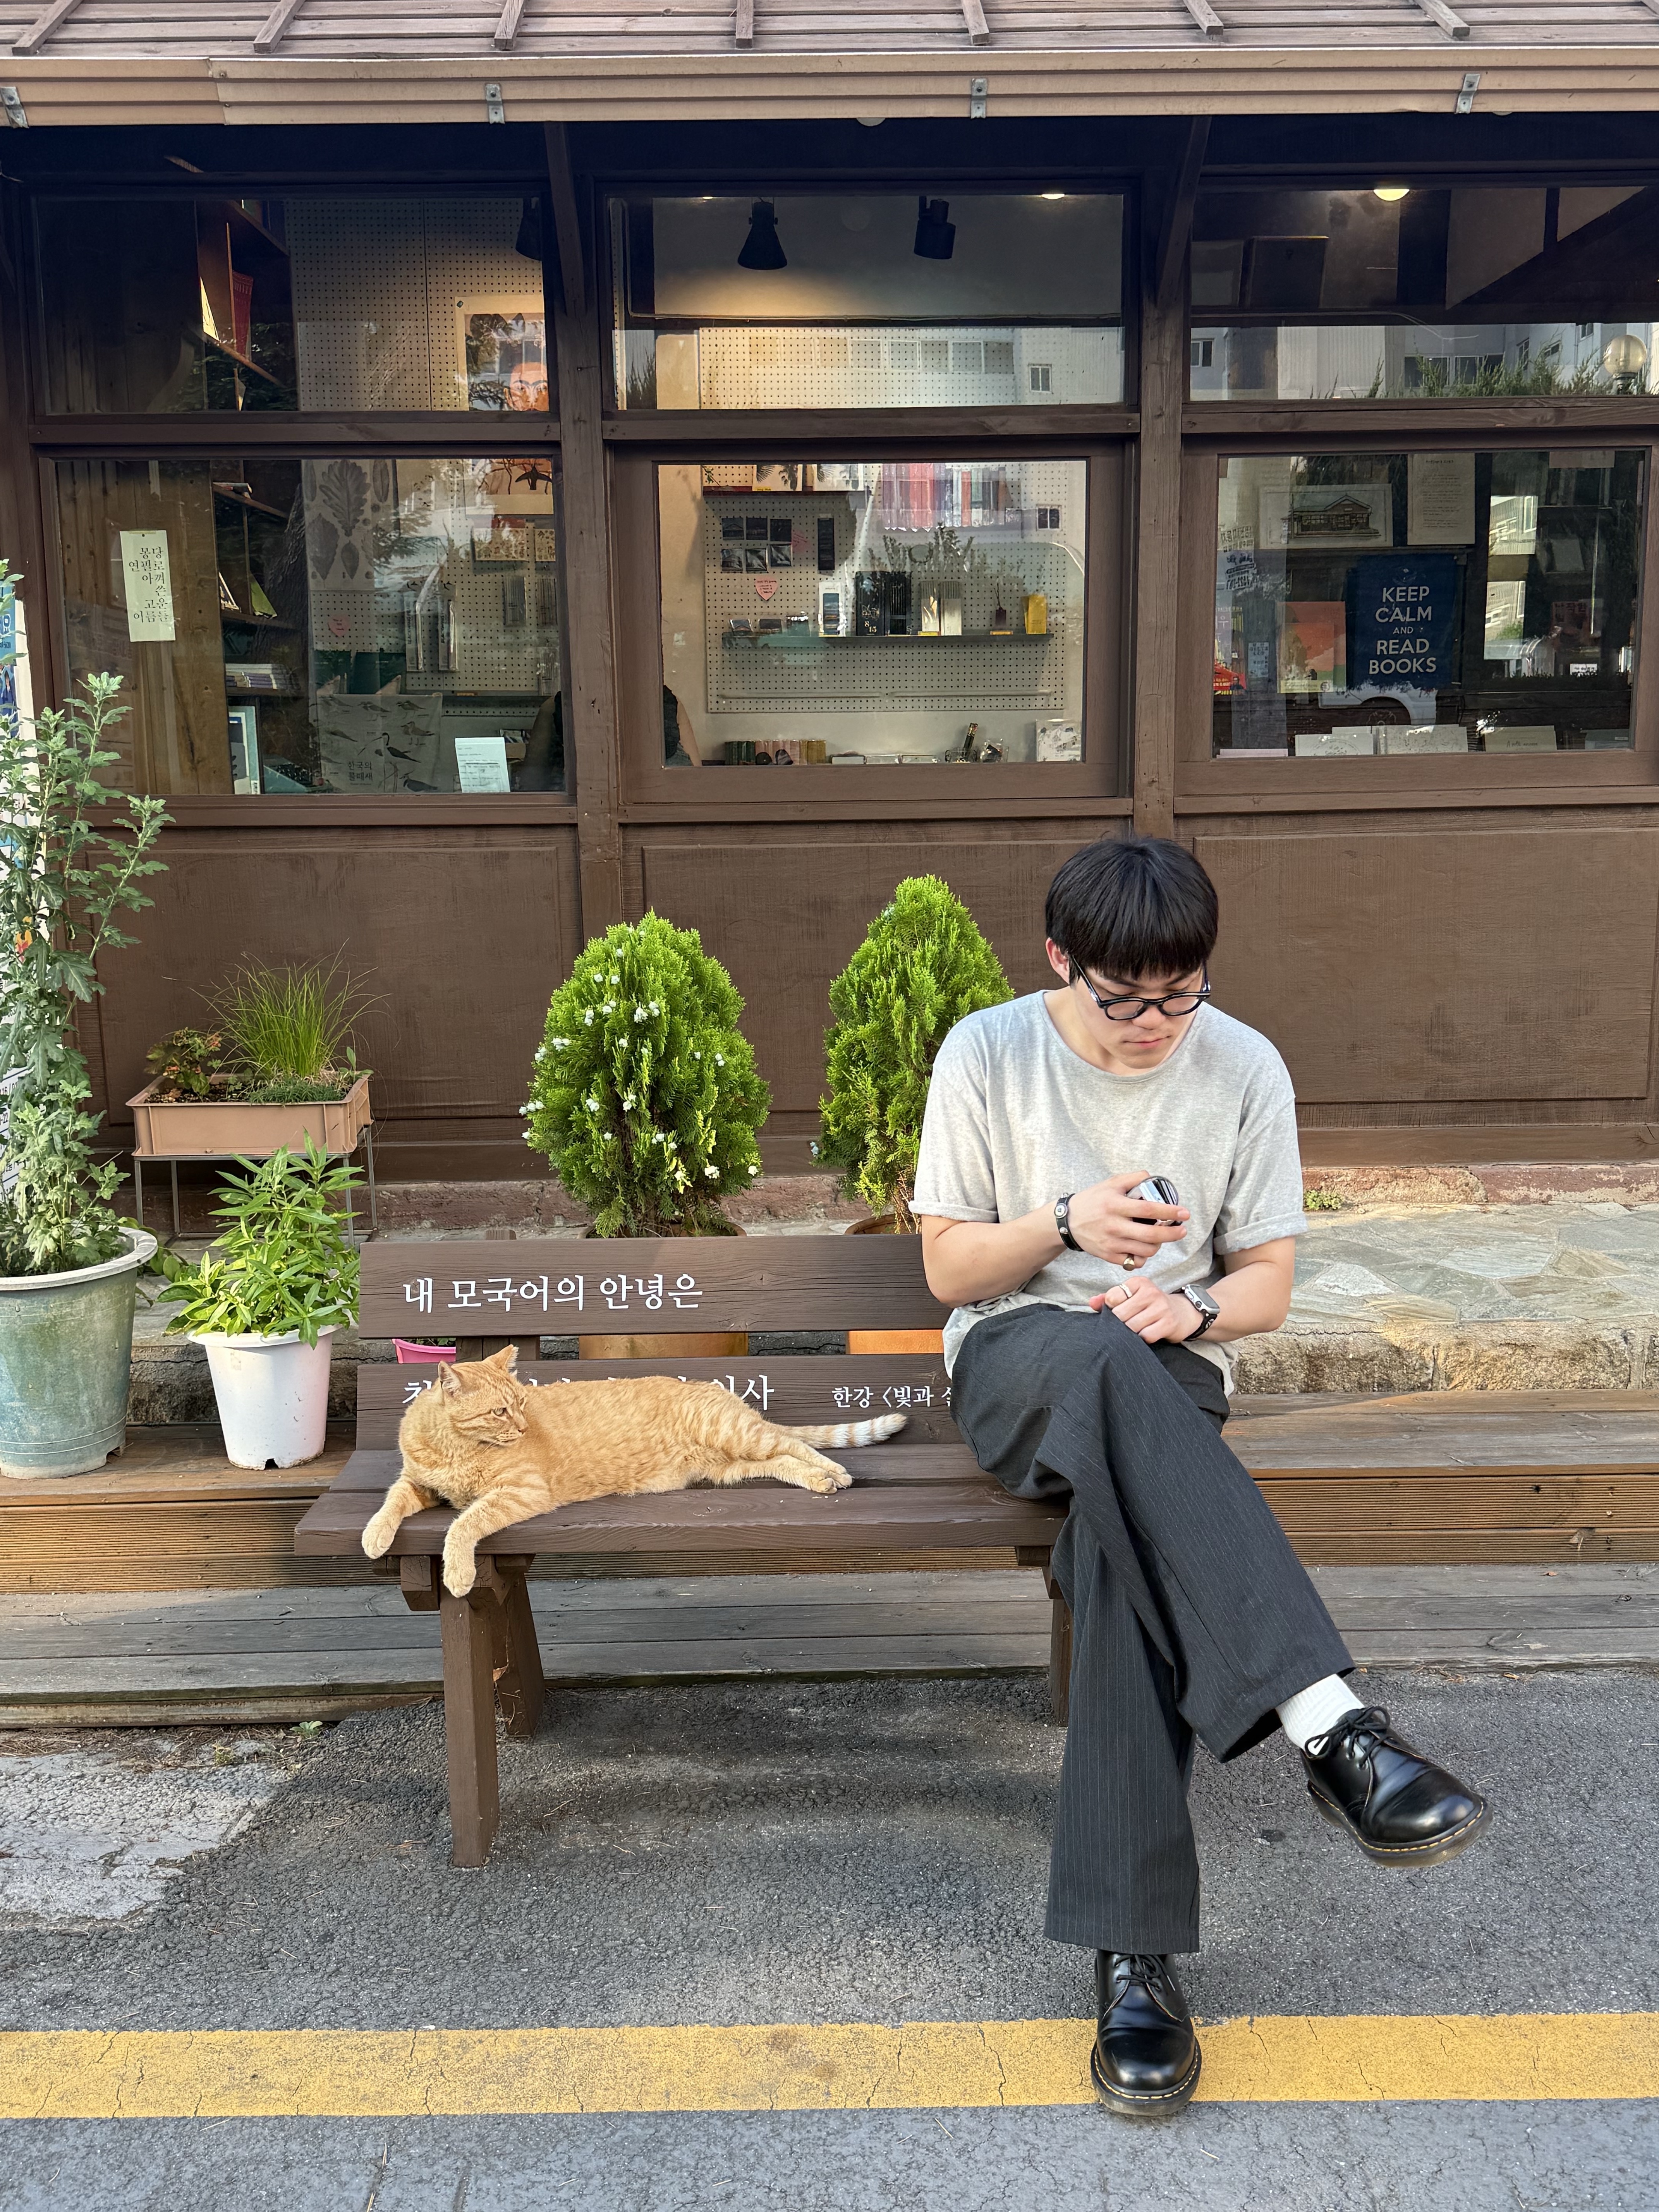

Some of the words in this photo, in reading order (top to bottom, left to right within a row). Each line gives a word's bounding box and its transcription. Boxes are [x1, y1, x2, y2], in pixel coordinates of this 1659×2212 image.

[139, 546, 164, 559] 몽당
[129, 560, 165, 572] 연필로
[155, 585, 167, 597] 쓴
[1382, 586, 1430, 602] KEEP
[144, 598, 168, 609] 고운
[134, 610, 169, 623] 이름들
[1375, 606, 1432, 623] CALM
[1377, 639, 1430, 655] READ
[1369, 657, 1436, 675] BOOKS
[349, 761, 372, 771] 한국의
[402, 1278, 433, 1313] 내
[447, 1274, 584, 1312] 모국어의
[599, 1274, 703, 1310] 안녕은
[831, 1386, 874, 1408] 한강
